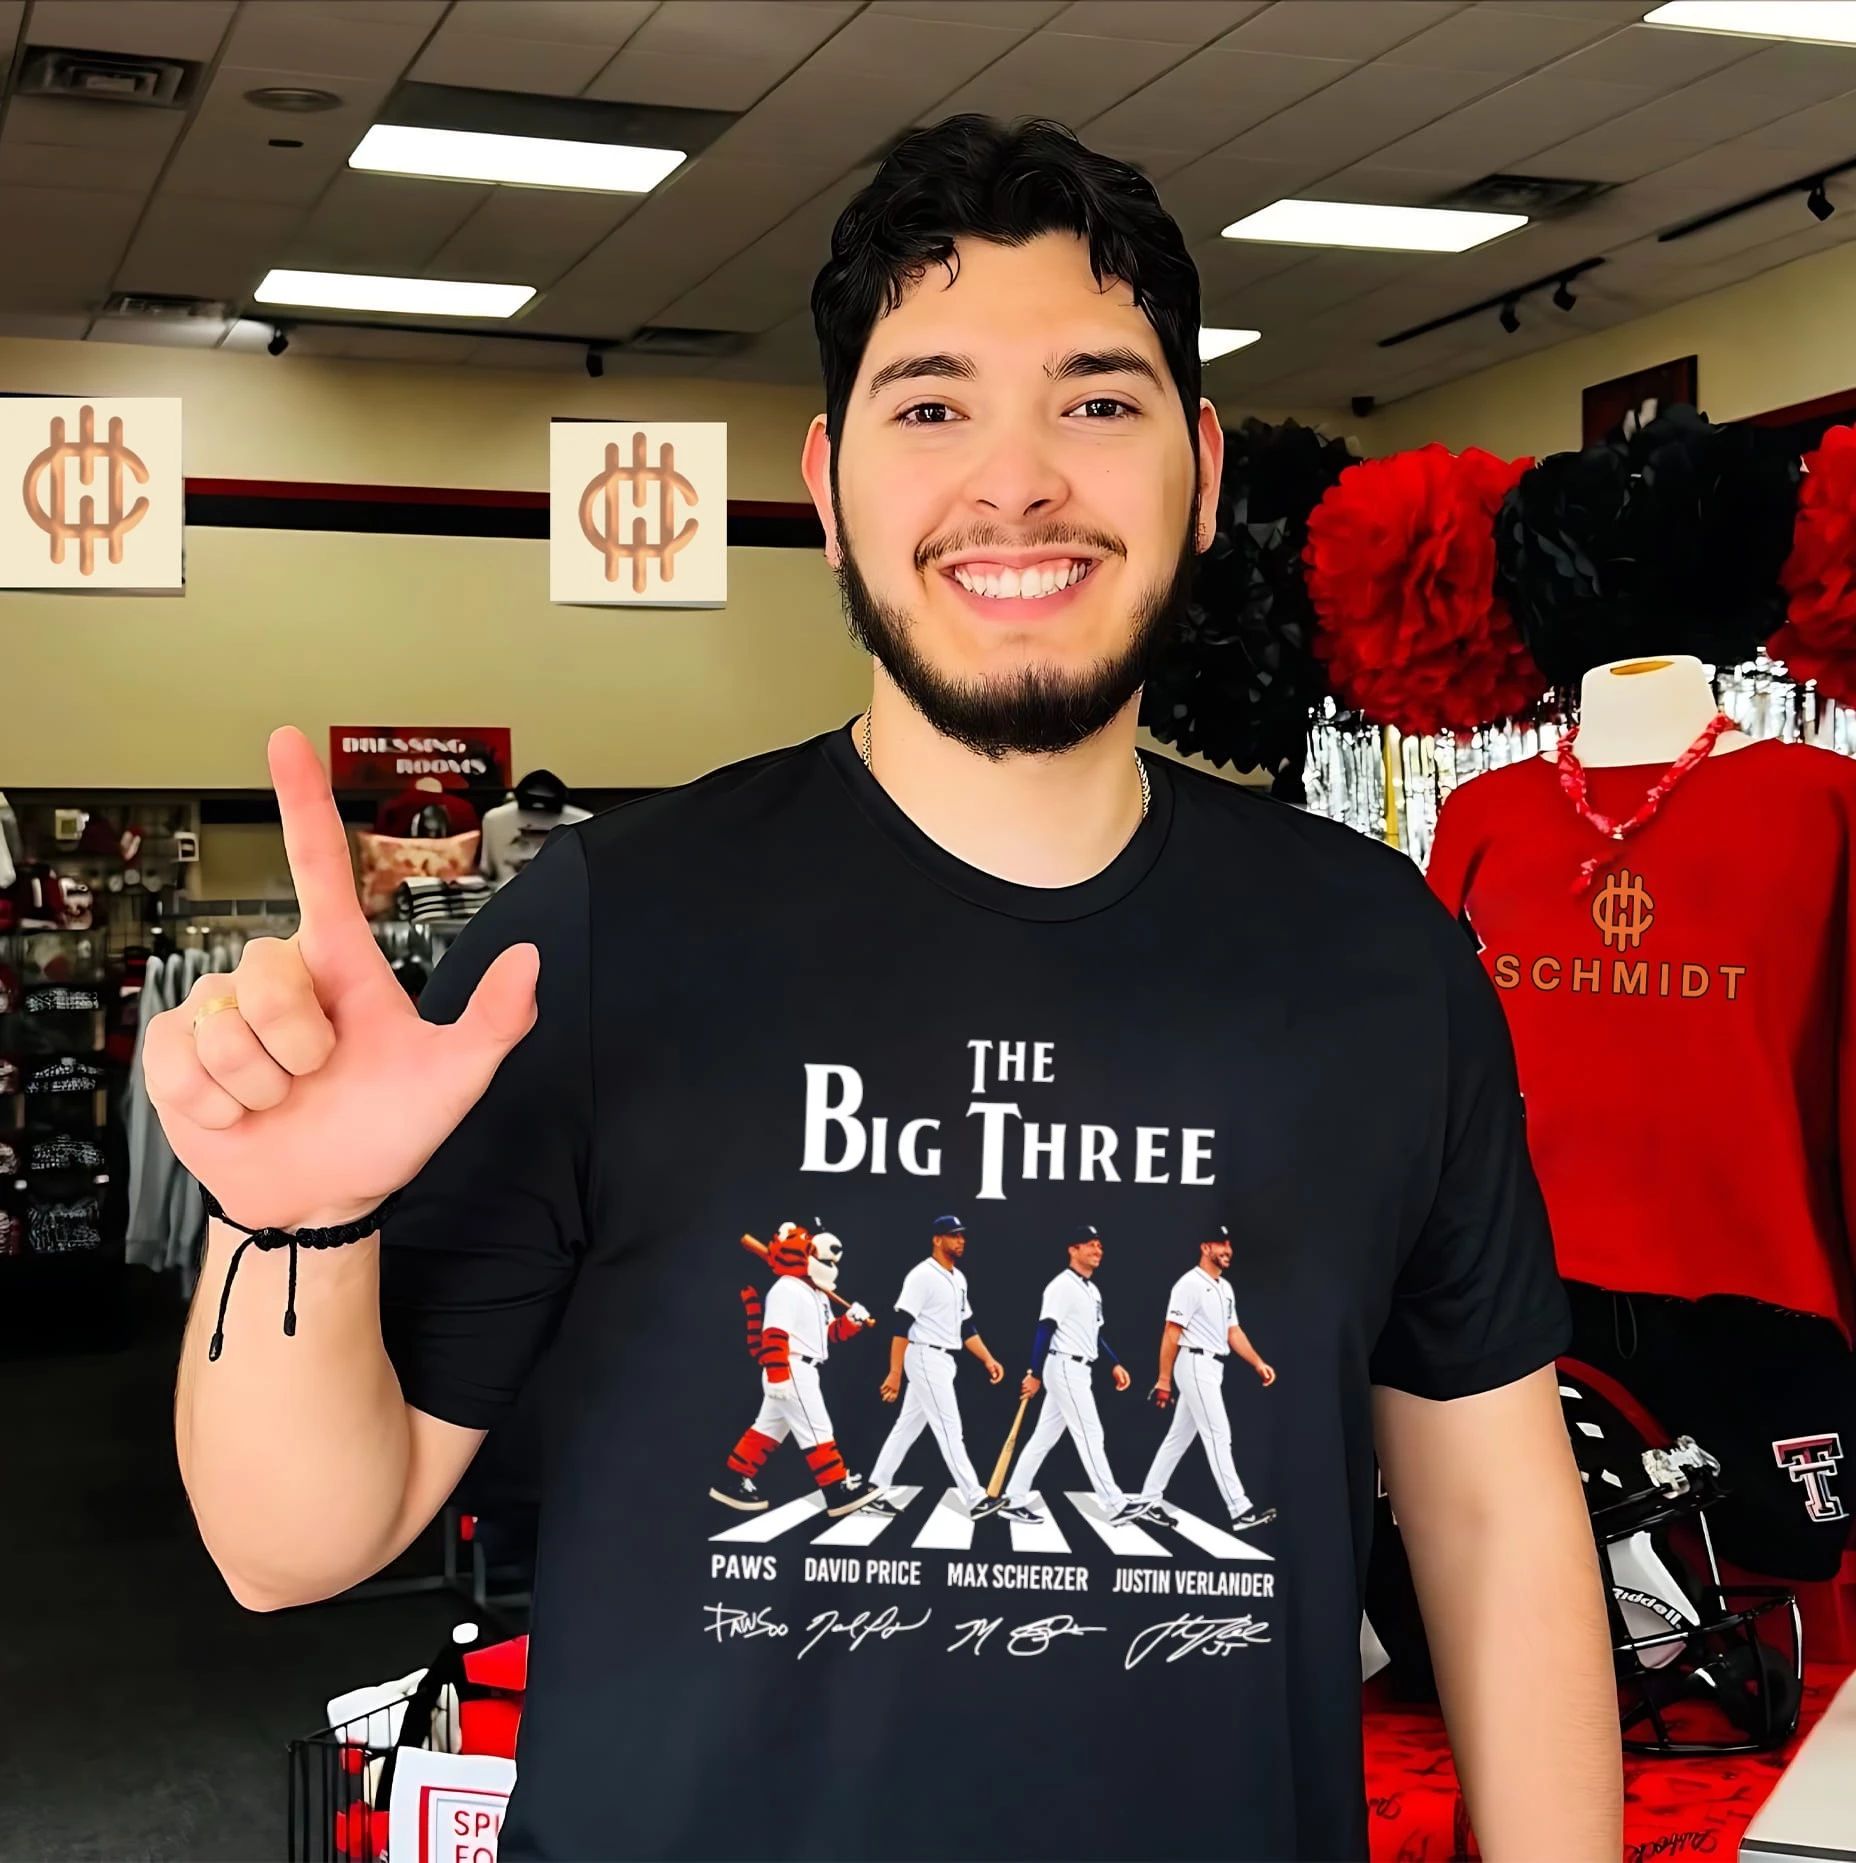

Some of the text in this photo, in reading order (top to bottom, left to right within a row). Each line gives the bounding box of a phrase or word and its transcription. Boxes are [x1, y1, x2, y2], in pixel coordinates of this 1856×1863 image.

[396, 758, 487, 775] ROOMS
[1494, 954, 1746, 1000] SCHMIDT
[711, 1554, 778, 1581] PAWS
[804, 1557, 922, 1585] DAVID PRICE
[946, 1562, 1089, 1592] MAX SCHERZER
[1112, 1567, 1275, 1598] JUSTIN VERLANDER
